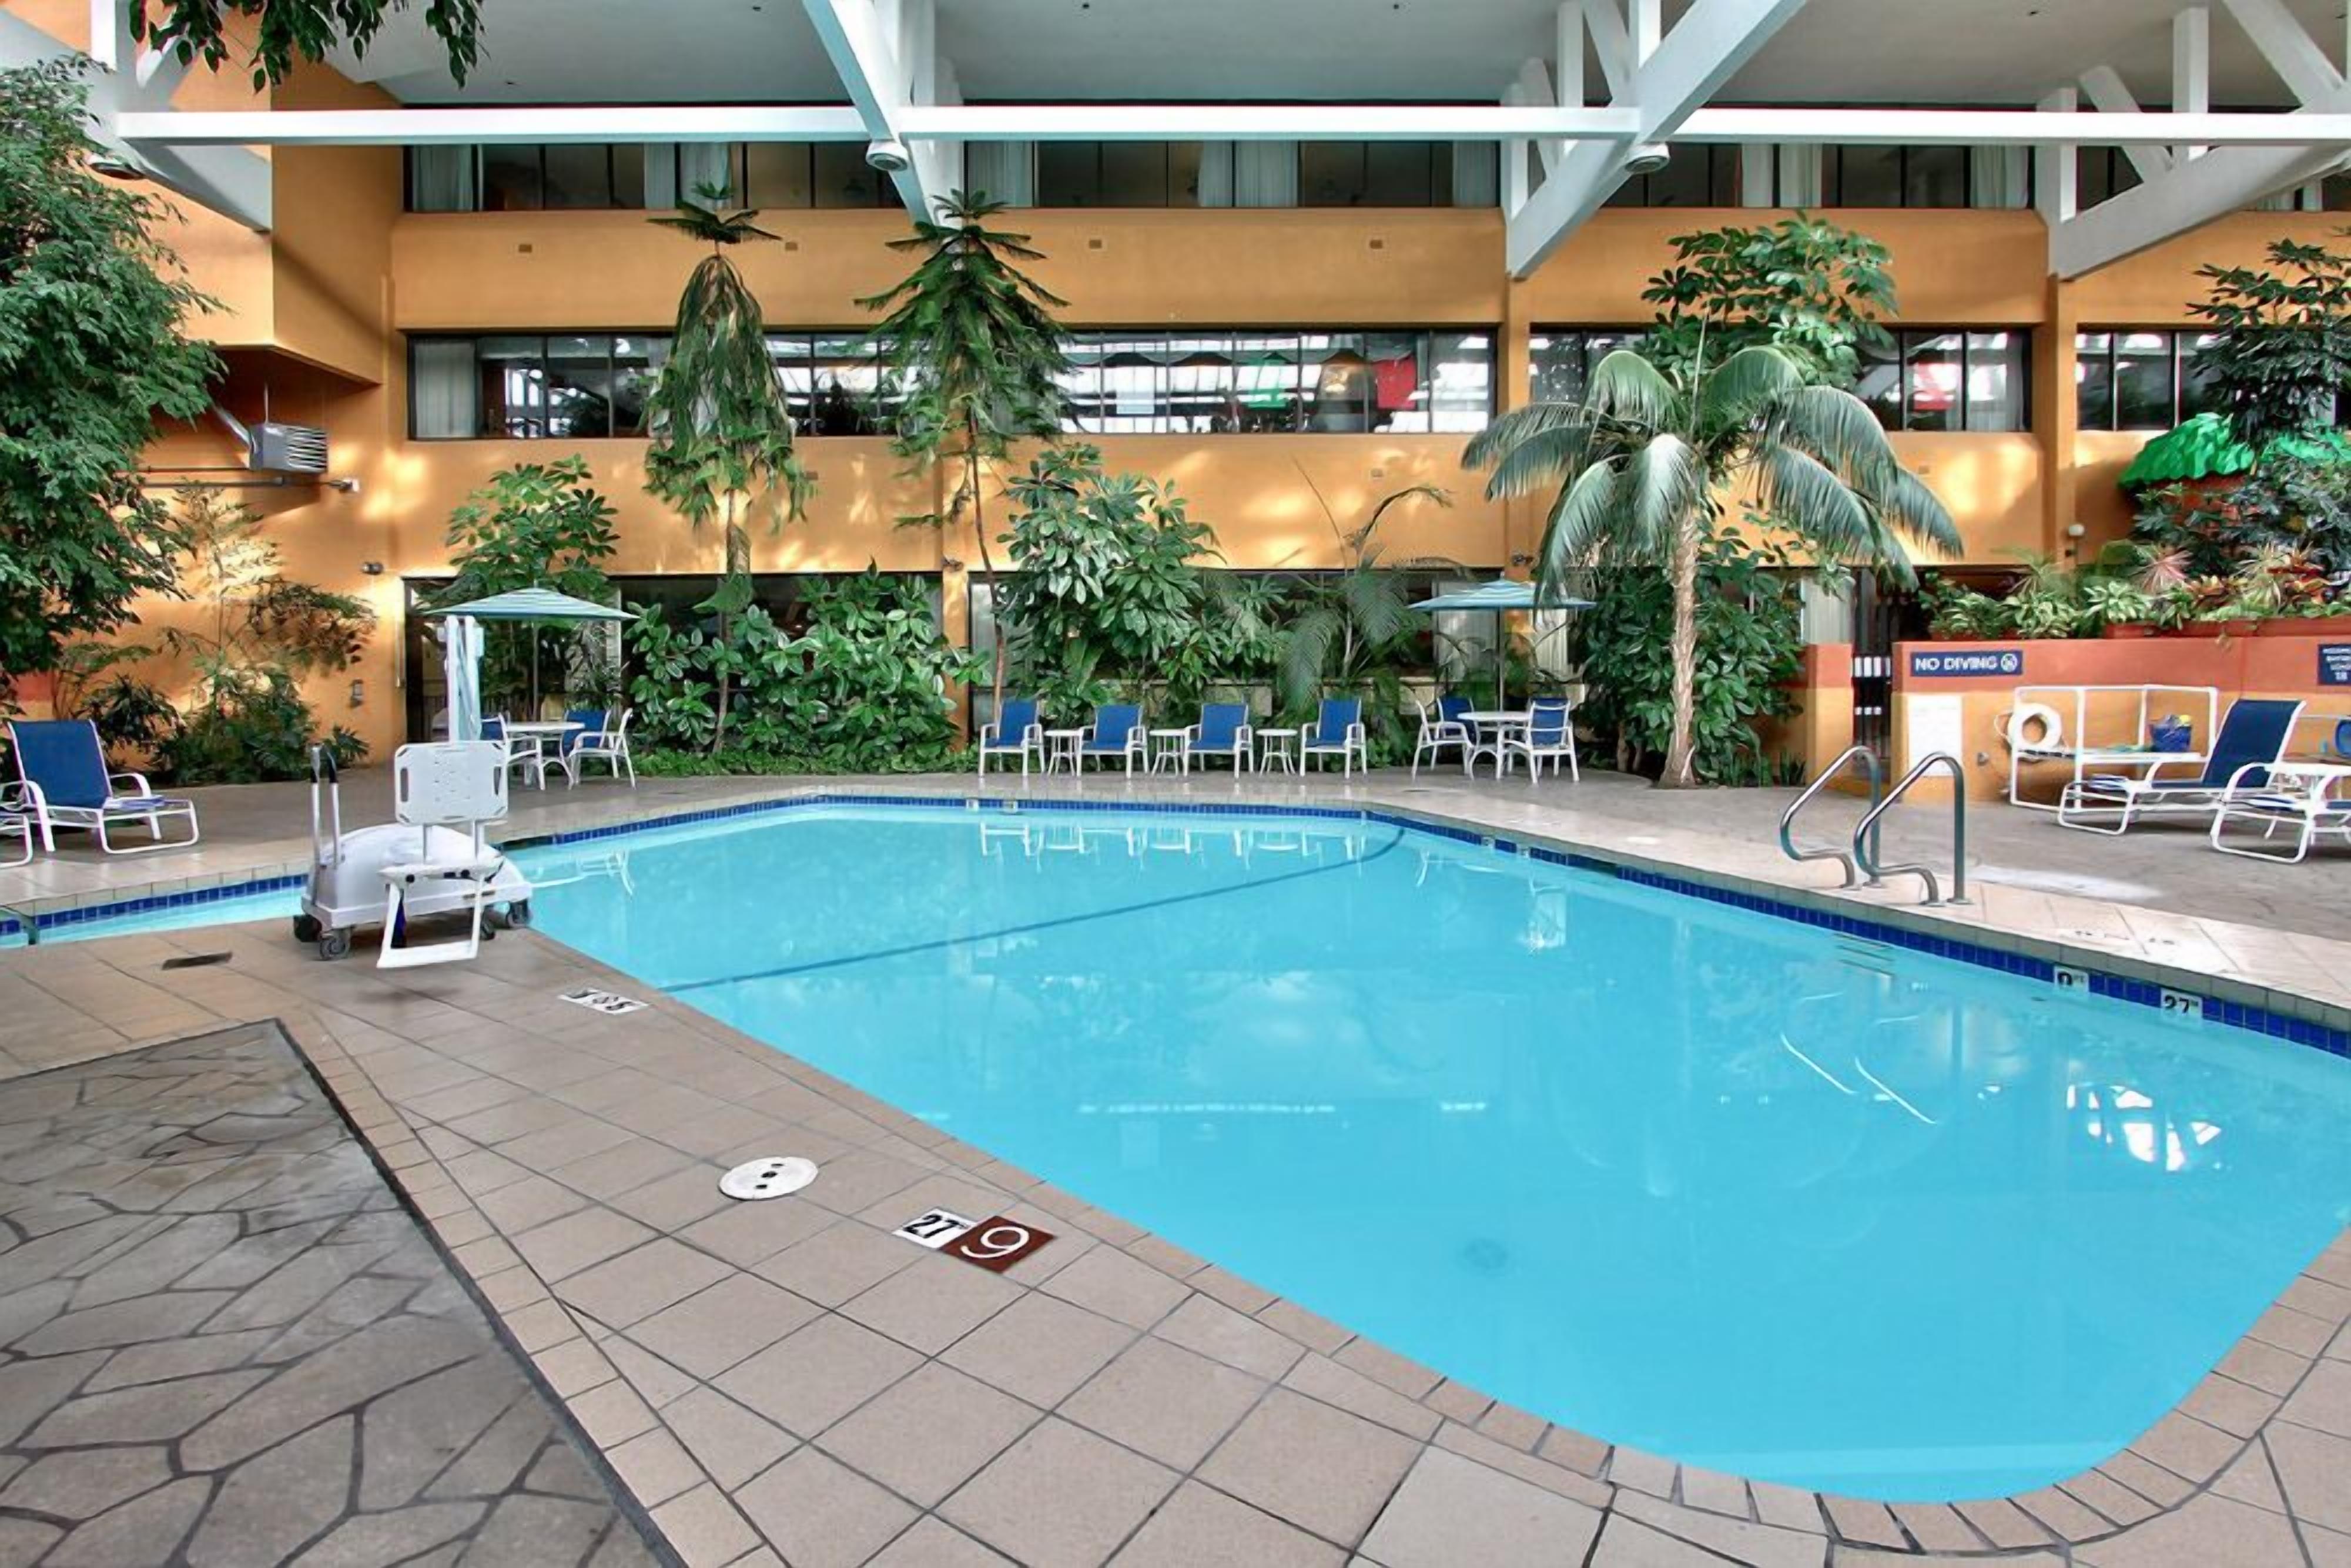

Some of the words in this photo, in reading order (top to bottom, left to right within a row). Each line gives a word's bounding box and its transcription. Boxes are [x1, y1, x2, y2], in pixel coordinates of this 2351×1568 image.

[1915, 658, 1940, 671] NO
[1944, 656, 1998, 670] DIVING
[960, 1225, 1030, 1258] 9
